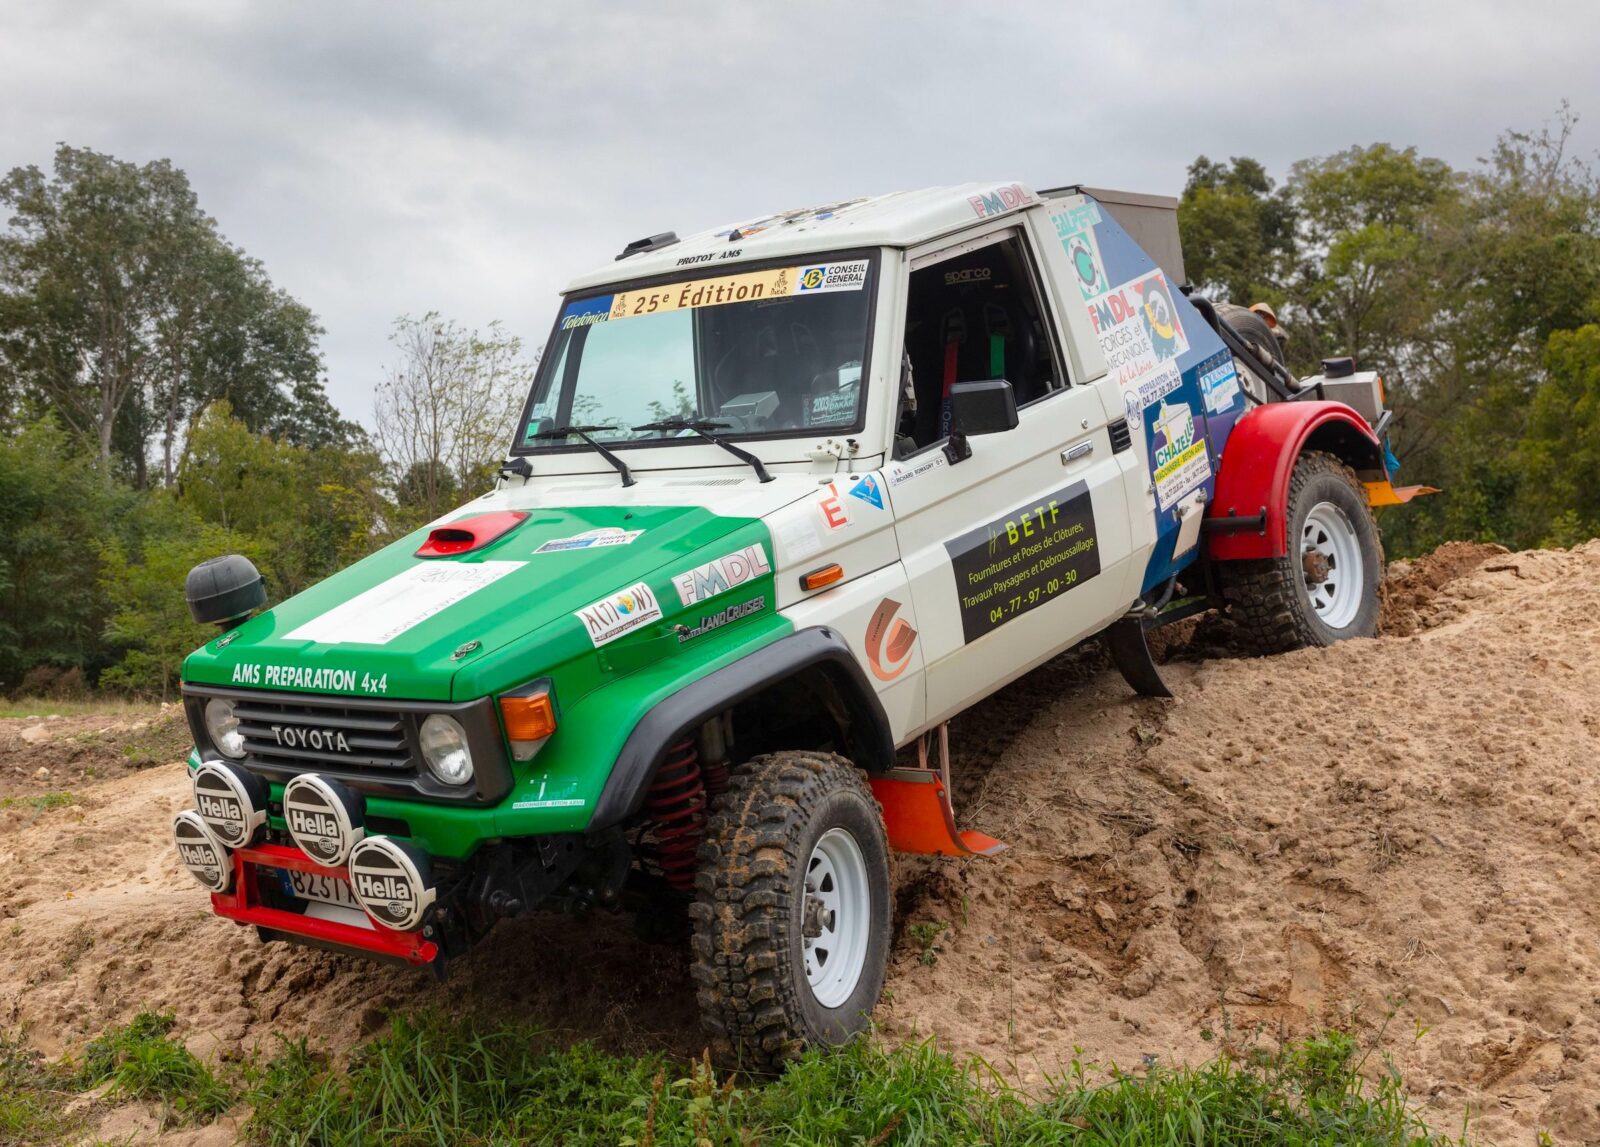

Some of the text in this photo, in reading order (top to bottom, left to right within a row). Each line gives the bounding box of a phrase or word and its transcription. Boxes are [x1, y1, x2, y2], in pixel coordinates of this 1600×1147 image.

[967, 183, 1033, 219] FMDL
[676, 249, 742, 266] PROTOY AMS
[828, 264, 865, 274] CONSEIL
[826, 273, 864, 284] GENERAL
[944, 267, 991, 282] sparco
[678, 282, 764, 307] Édition
[1088, 289, 1136, 335] FMDL
[1099, 322, 1144, 354] FORGES et
[1157, 415, 1194, 467] CHAZELLE
[1005, 500, 1059, 546] BETF
[968, 522, 1084, 585] Fournitures et Poses de Clôtures,
[675, 546, 769, 607] FMDL
[963, 537, 1094, 609] Travaux Paysagers et Débroussaillage
[232, 663, 387, 693] AMS PREPARATION 4x4
[271, 726, 351, 752] TOYOTA
[200, 795, 241, 820] Hella
[291, 810, 339, 837] Hella
[180, 844, 218, 865] Hella
[357, 874, 410, 900] Hella
